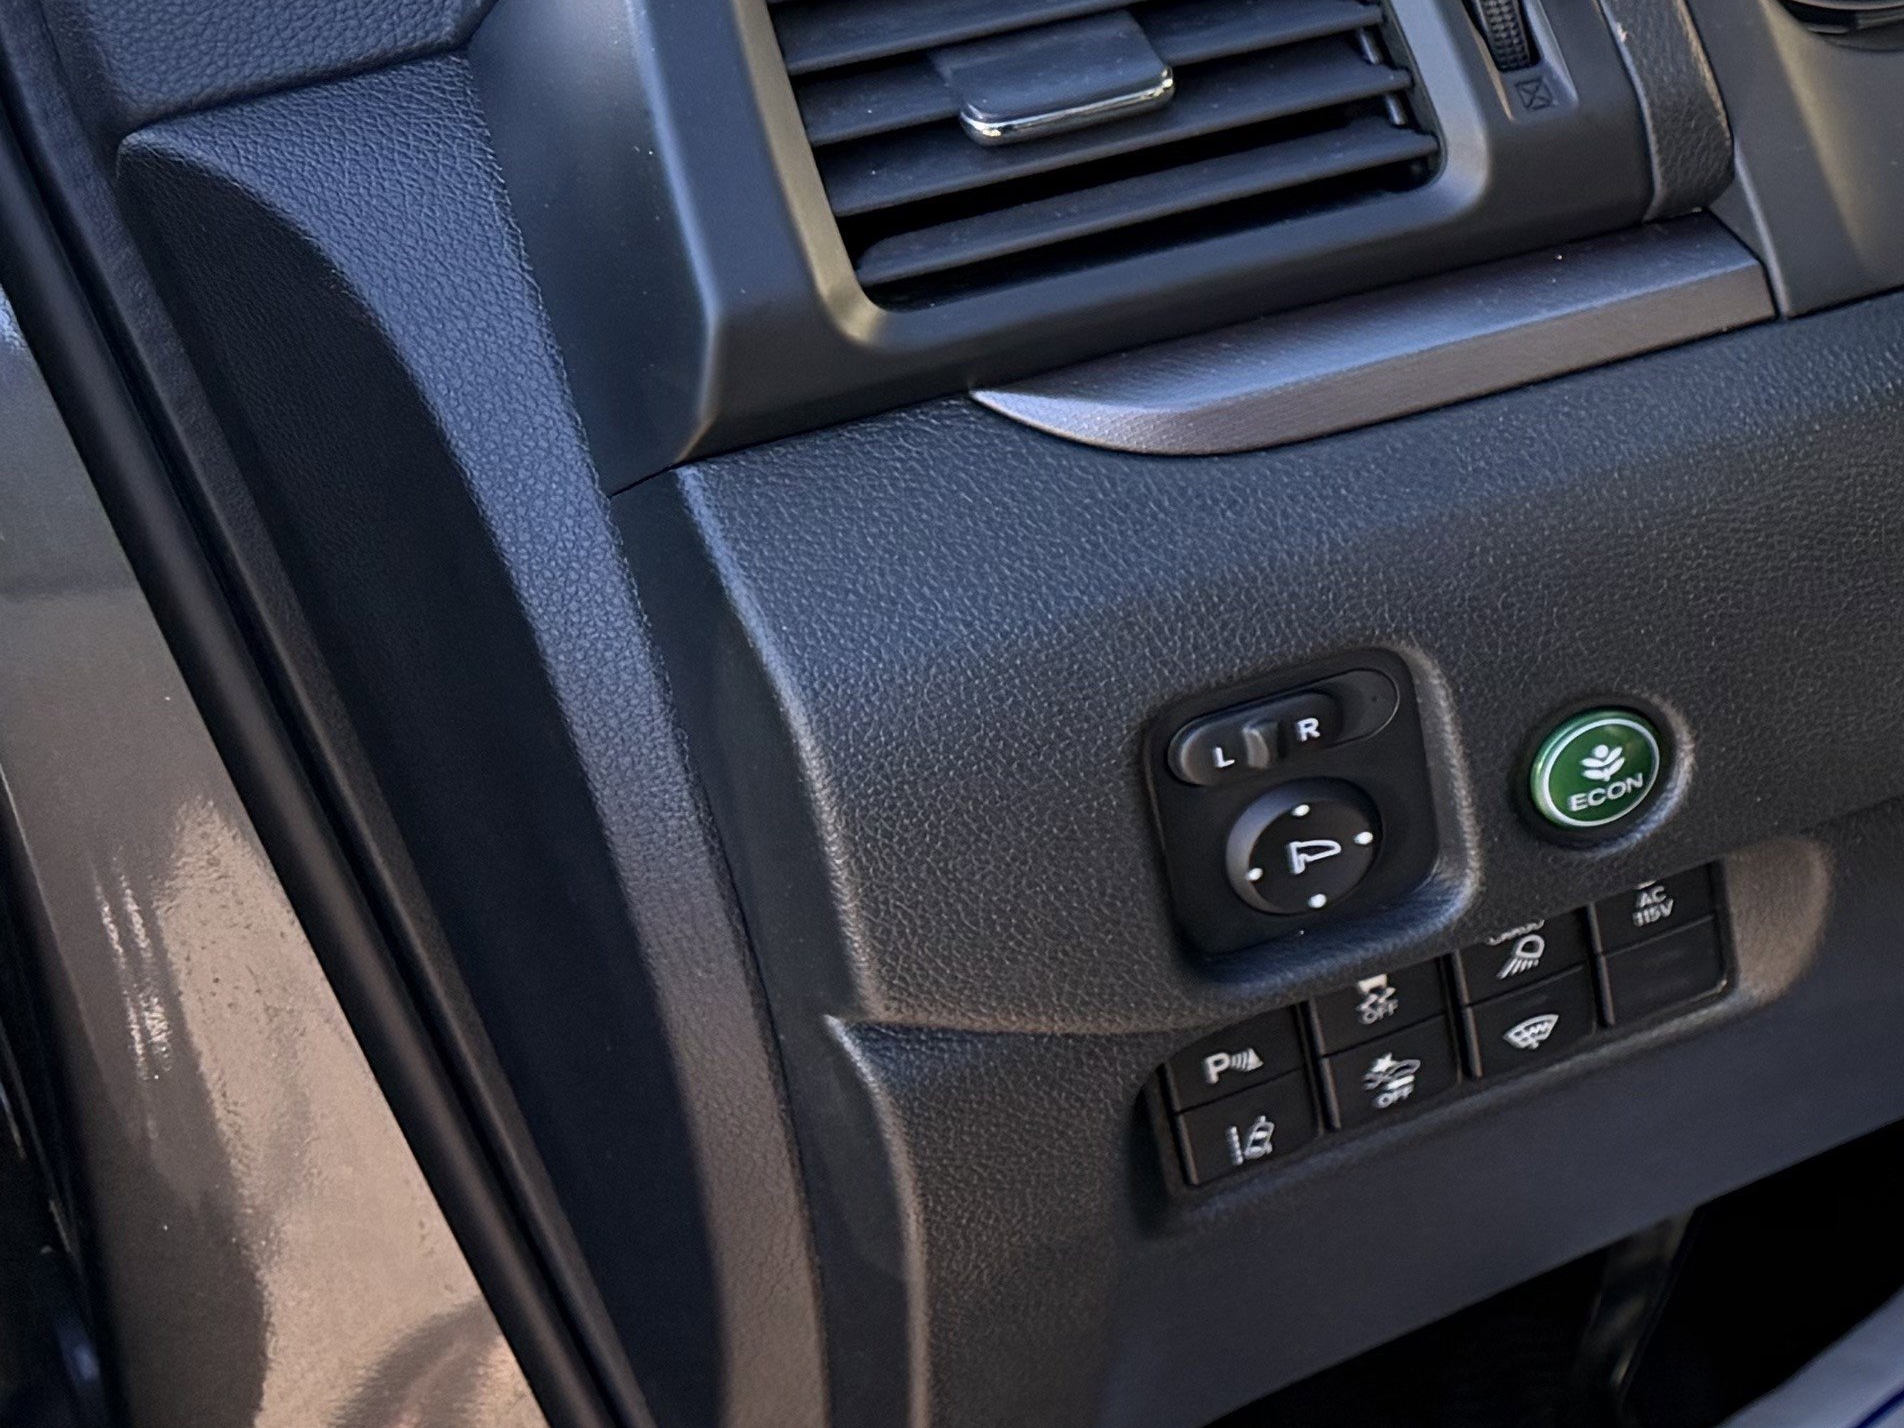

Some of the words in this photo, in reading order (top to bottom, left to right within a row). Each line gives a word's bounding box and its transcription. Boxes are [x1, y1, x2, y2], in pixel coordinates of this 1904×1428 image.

[1296, 717, 1320, 741] R
[1212, 747, 1234, 768] L
[1569, 772, 1644, 812] ECON
[1635, 885, 1667, 908] AC
[1632, 898, 1674, 927] 115V
[1361, 999, 1398, 1025] OFF
[1372, 1085, 1414, 1109] OFF
